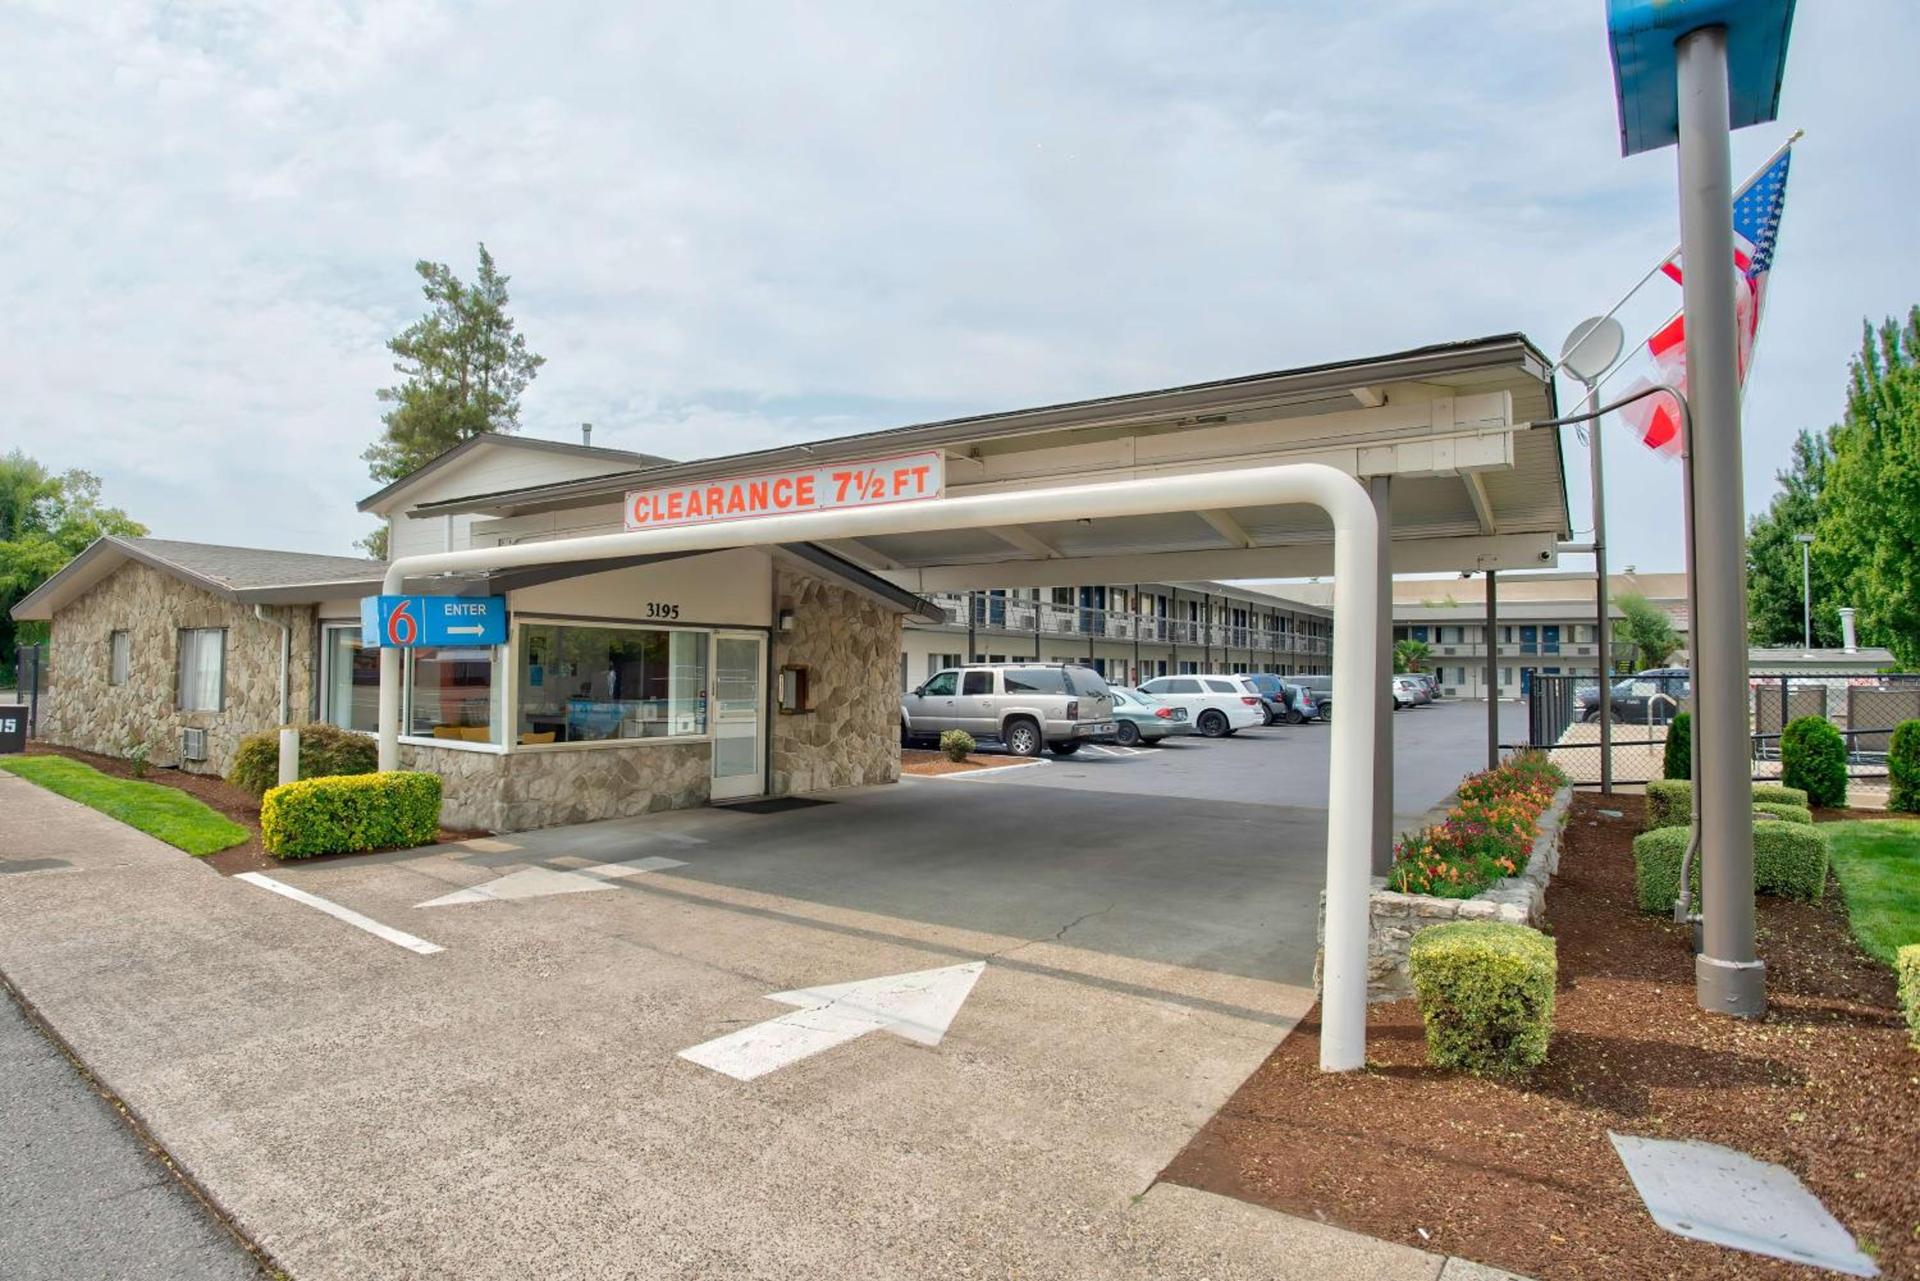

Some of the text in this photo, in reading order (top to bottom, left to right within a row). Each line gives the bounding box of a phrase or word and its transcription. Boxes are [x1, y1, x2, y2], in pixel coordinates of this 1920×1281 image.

[634, 475, 816, 523] CLEARANCE
[893, 466, 930, 496] FT
[444, 603, 487, 616] ENTER
[646, 601, 680, 620] 3195
[387, 599, 418, 646] 6
[0, 718, 16, 733] 5
